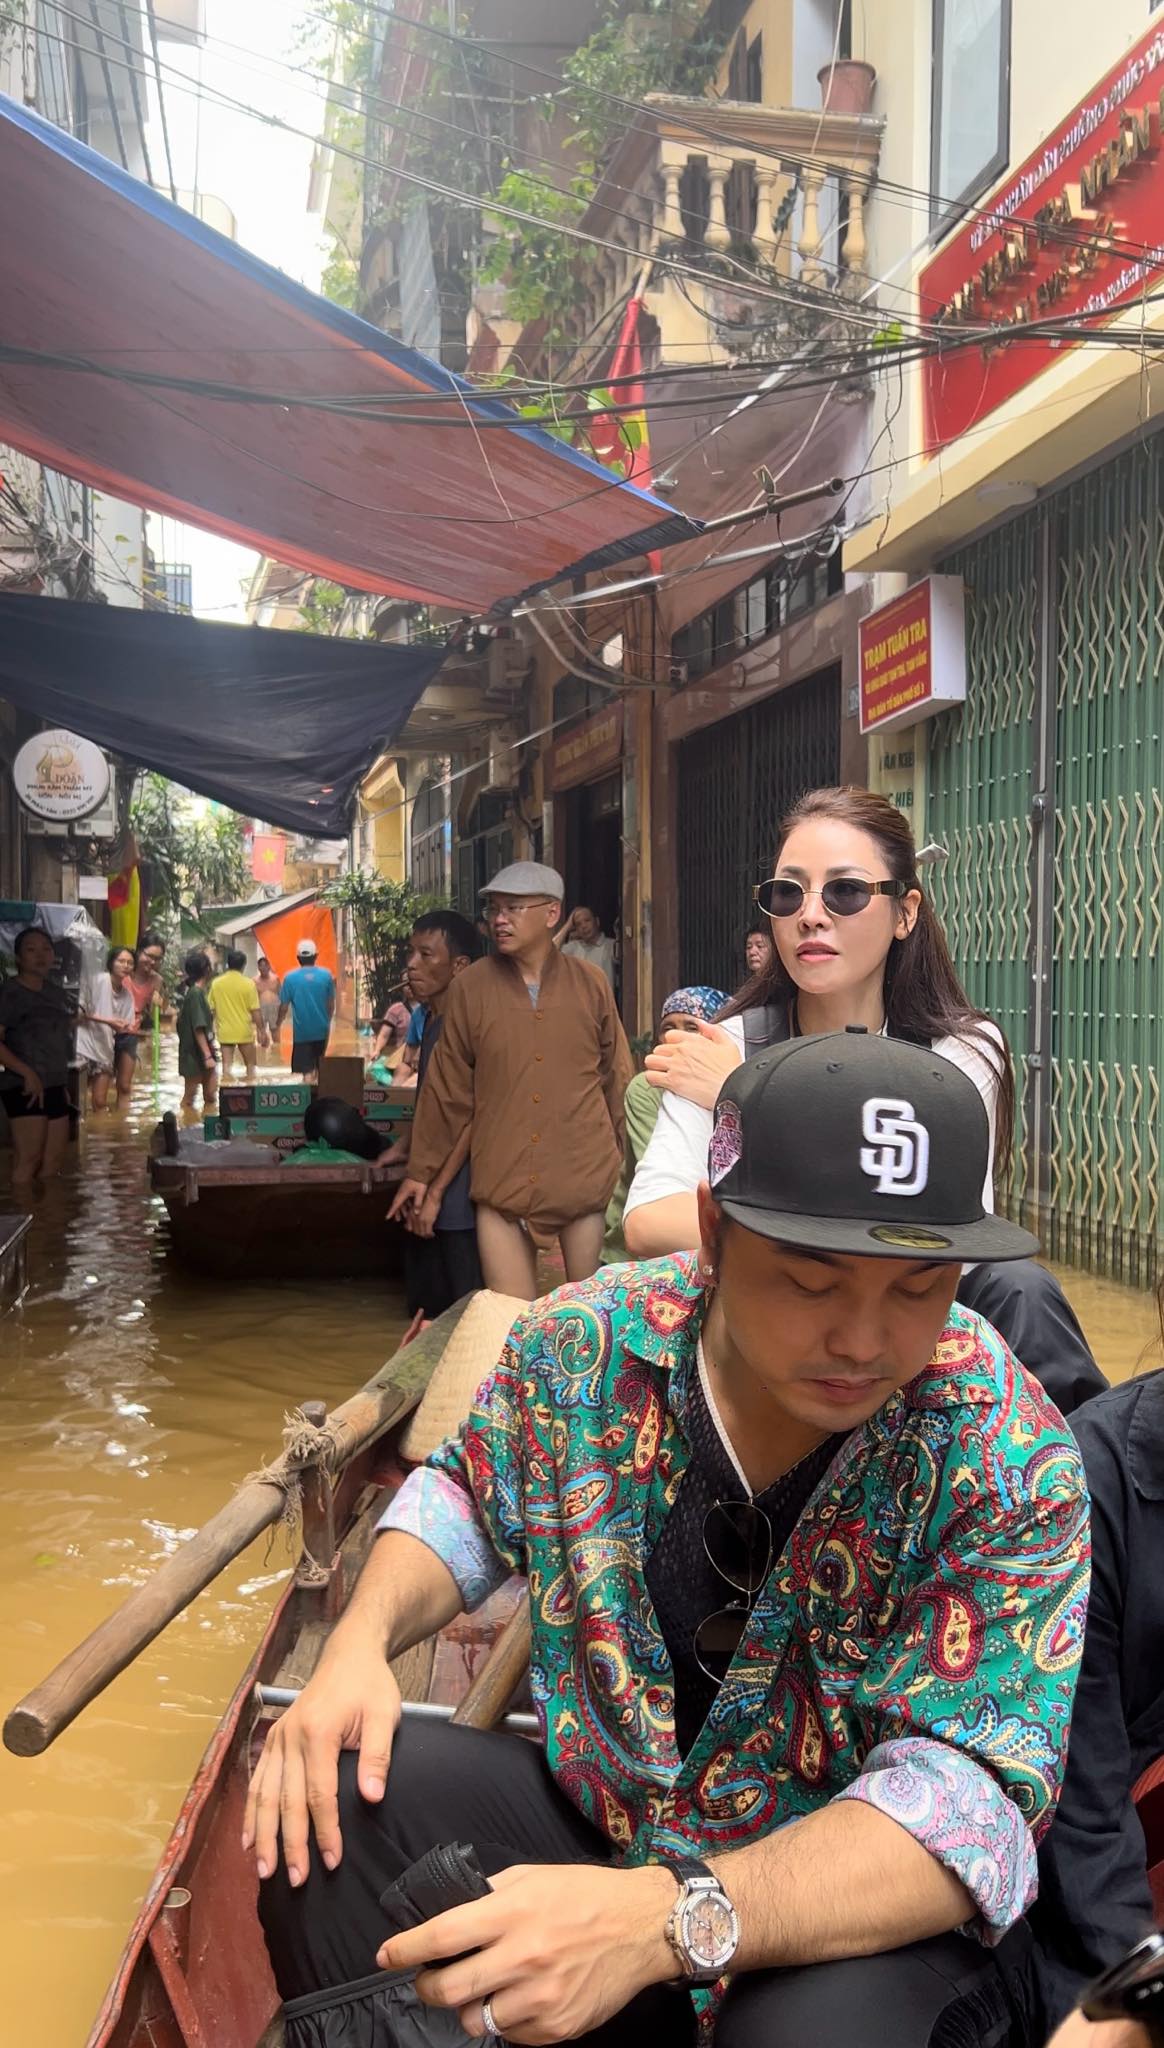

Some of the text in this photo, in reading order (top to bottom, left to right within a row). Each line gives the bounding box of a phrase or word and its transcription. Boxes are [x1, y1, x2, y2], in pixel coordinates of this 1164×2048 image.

[1059, 97, 1108, 162] PHƯỜNG
[1109, 58, 1145, 112] PHÚC
[864, 641, 887, 672] TRẠM
[910, 618, 927, 645] TRA
[860, 1097, 929, 1195] SD
